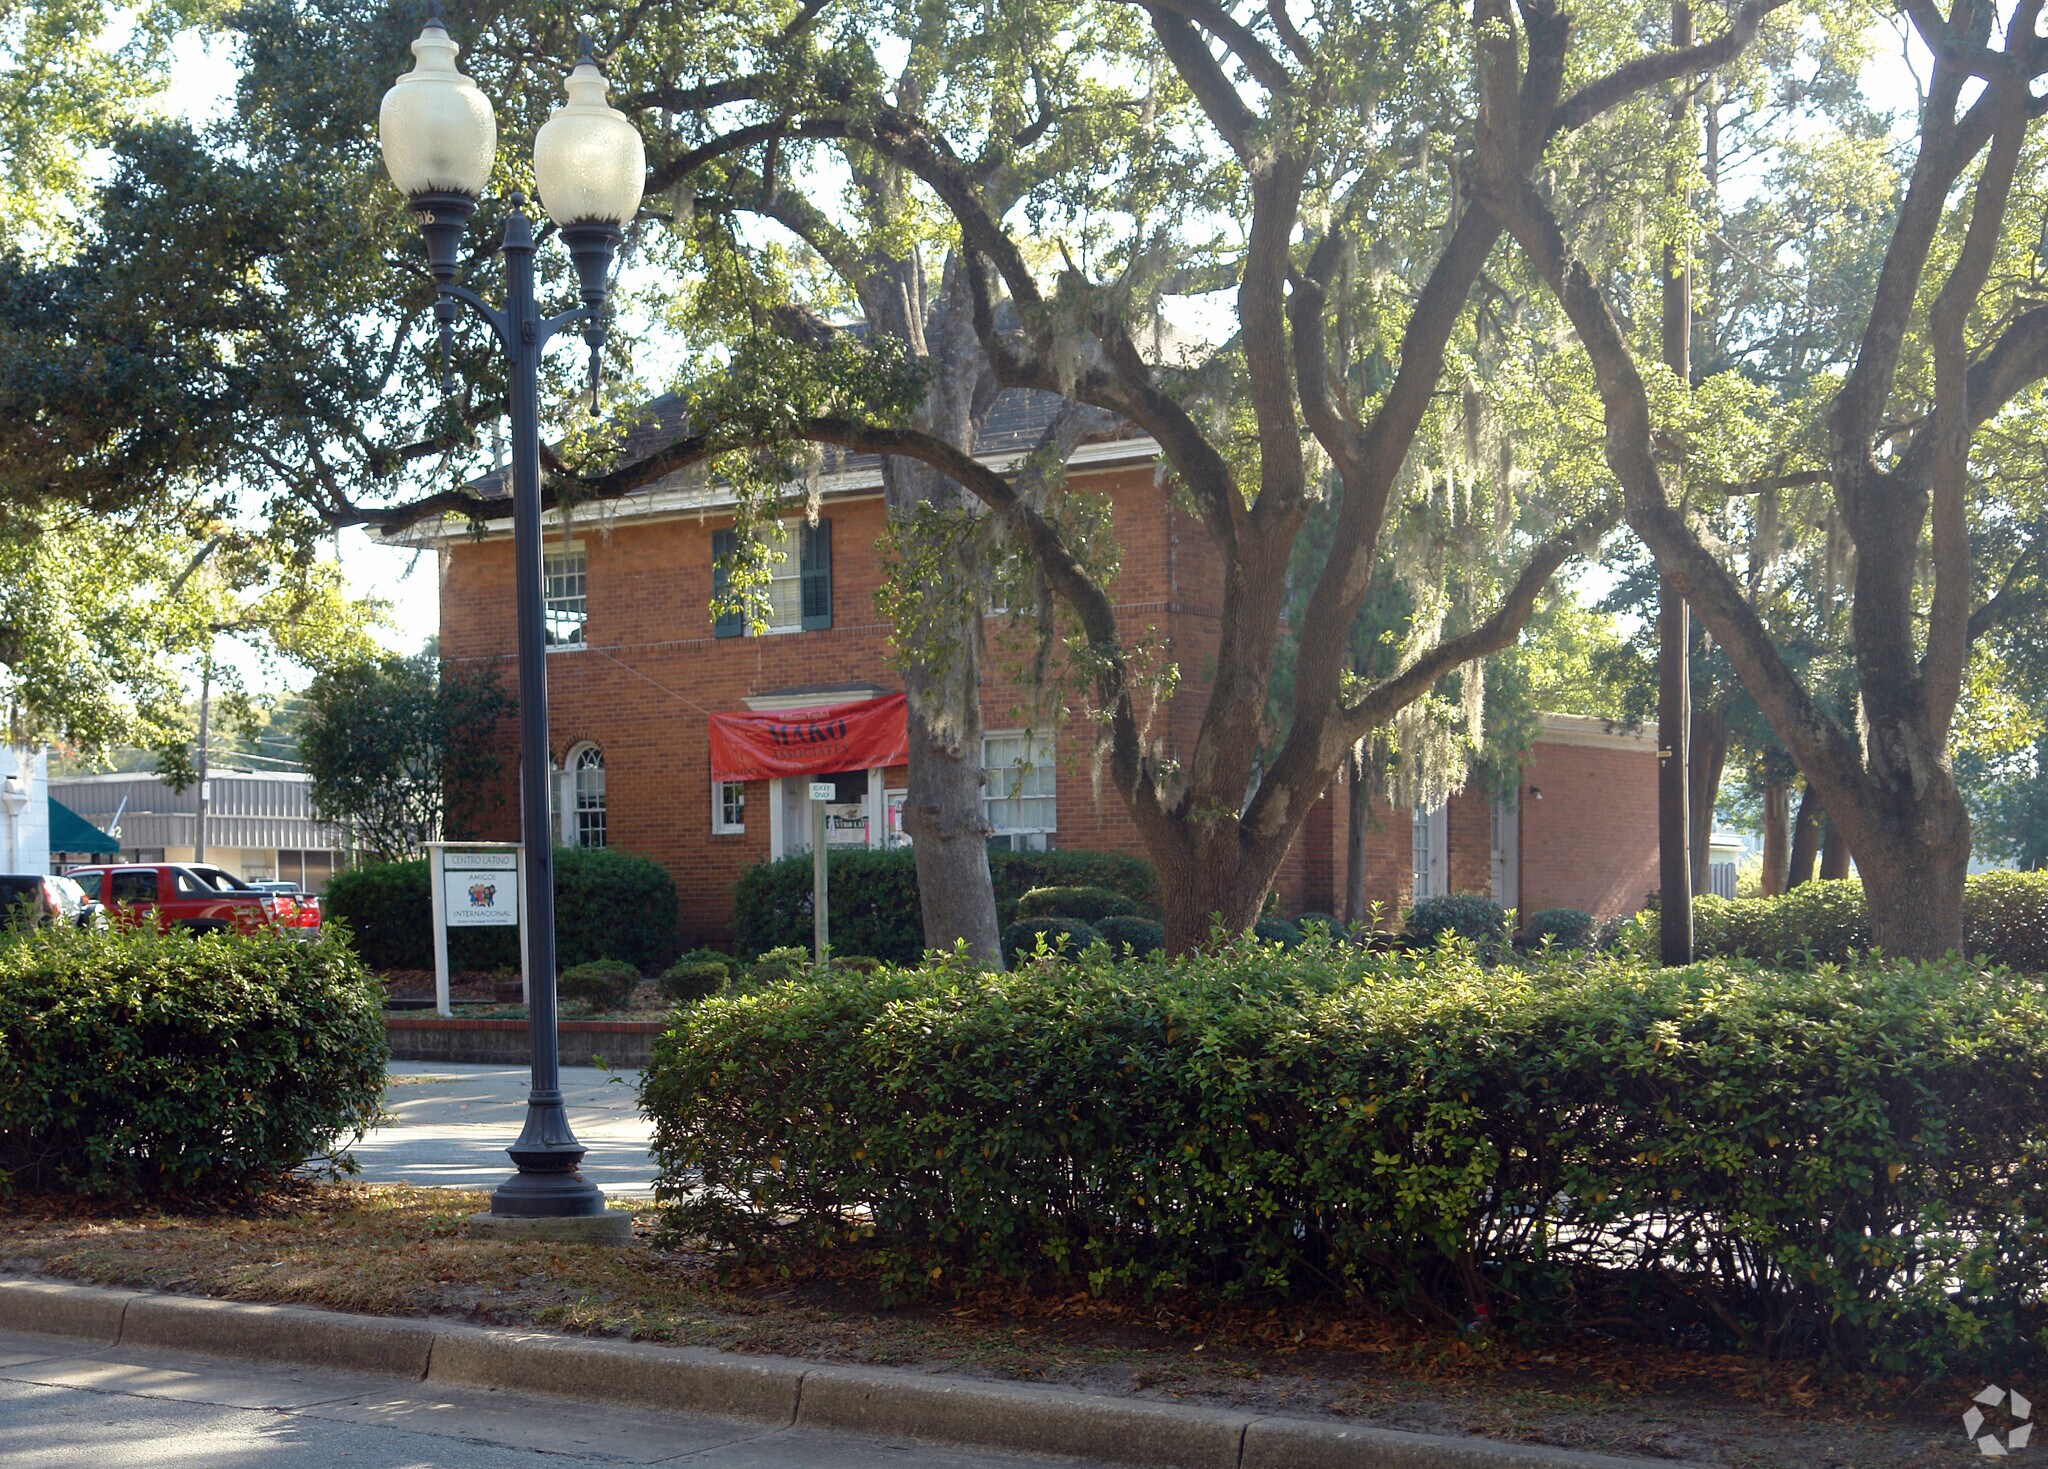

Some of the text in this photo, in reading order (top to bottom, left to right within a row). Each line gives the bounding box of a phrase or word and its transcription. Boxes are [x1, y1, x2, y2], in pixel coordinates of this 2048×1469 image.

[769, 719, 846, 746] MAKO
[773, 742, 848, 760] ASSOCIATES
[452, 855, 510, 865] CENTRO LATINO
[453, 910, 511, 918] INTERNACIONAL
